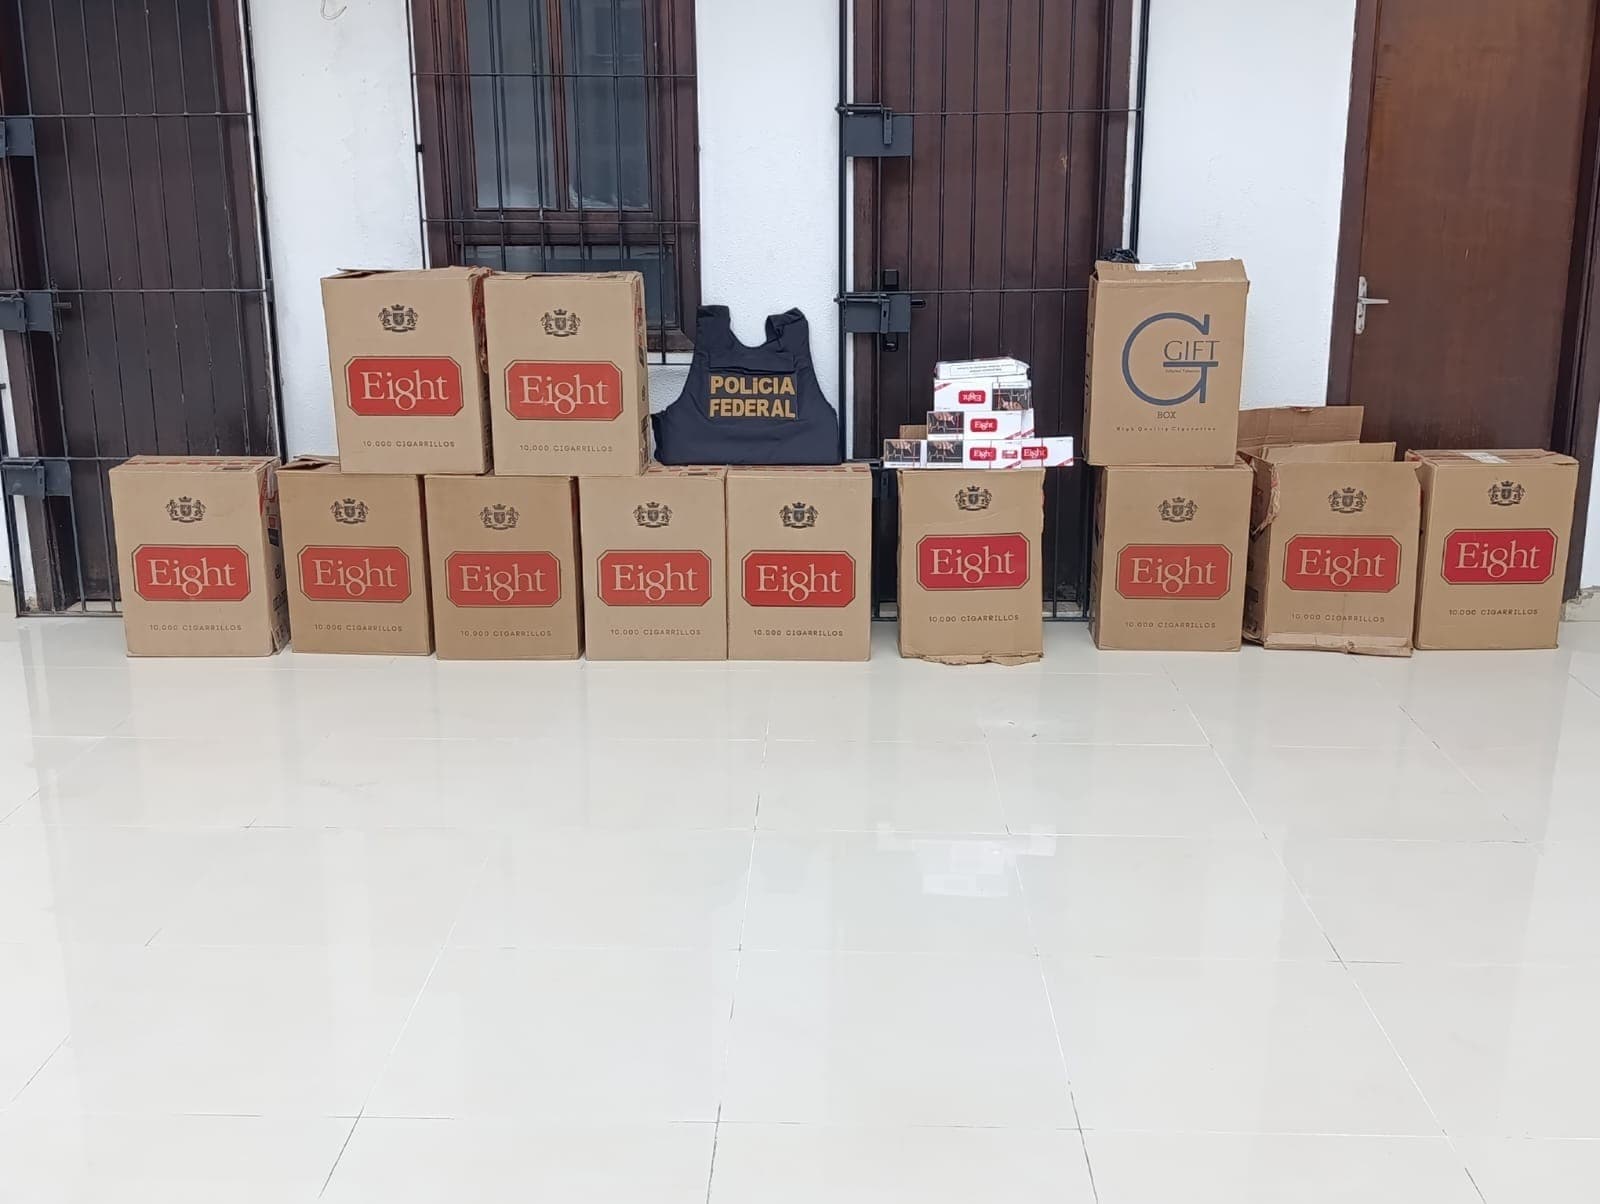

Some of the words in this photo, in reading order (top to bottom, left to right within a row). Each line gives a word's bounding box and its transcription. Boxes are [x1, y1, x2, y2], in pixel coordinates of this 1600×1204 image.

[1163, 340, 1221, 361] GIFT
[709, 398, 796, 418] FEDERAL
[1157, 411, 1177, 419] BOX
[395, 440, 455, 448] CIGARRILLOS
[552, 444, 613, 453] CIGARRILLOS
[1480, 608, 1538, 616] CIGARRILLOS
[960, 614, 1019, 622] CIGARRILLOS
[1324, 614, 1385, 623] CIGARRILLOS
[345, 624, 403, 632] CIGARRILLOS
[1157, 621, 1216, 629] CIGARRILLOS
[785, 629, 844, 637] CIGARRILLOS
